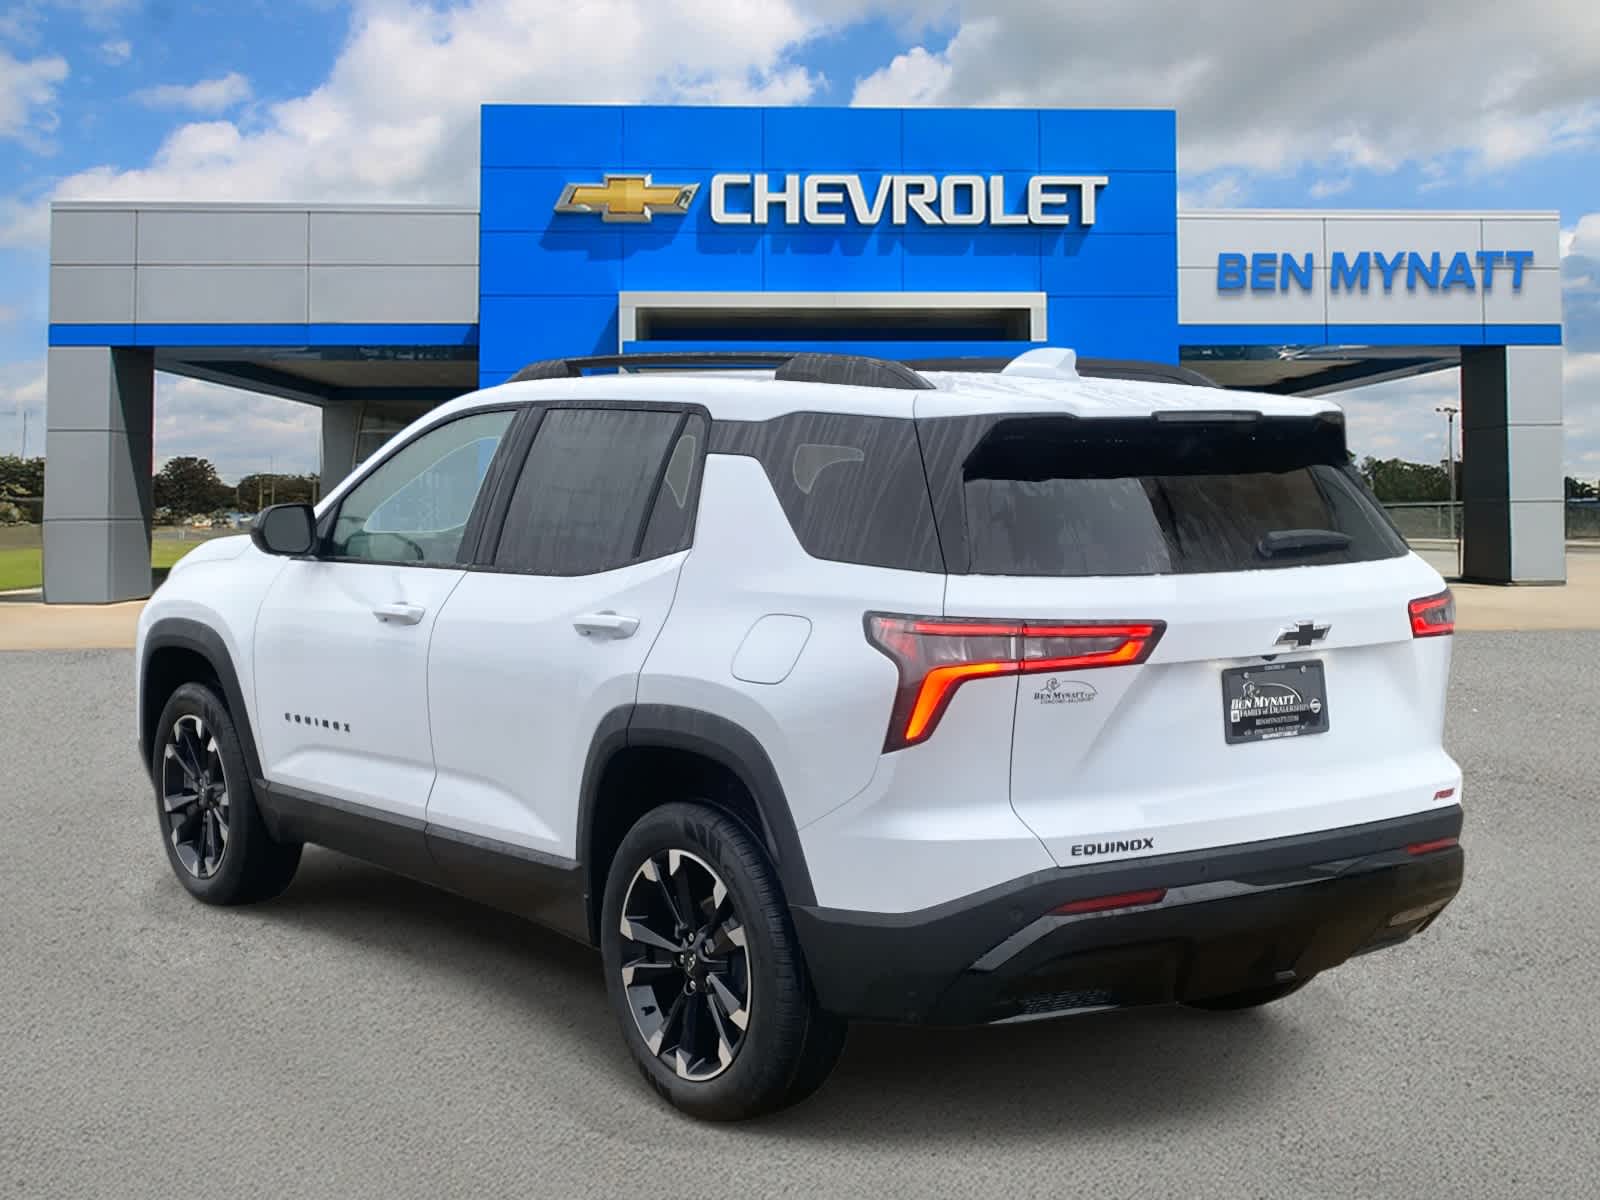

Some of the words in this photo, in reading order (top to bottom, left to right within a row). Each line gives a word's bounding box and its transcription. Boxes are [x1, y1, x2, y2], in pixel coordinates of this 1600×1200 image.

[711, 173, 1109, 225] CHEVROLET
[1217, 252, 1314, 290] BEN
[1329, 250, 1535, 289] MYNATT
[1231, 699, 1252, 709] BEN
[1253, 695, 1295, 708] MYNATT
[1072, 838, 1153, 856] EQUINOX
